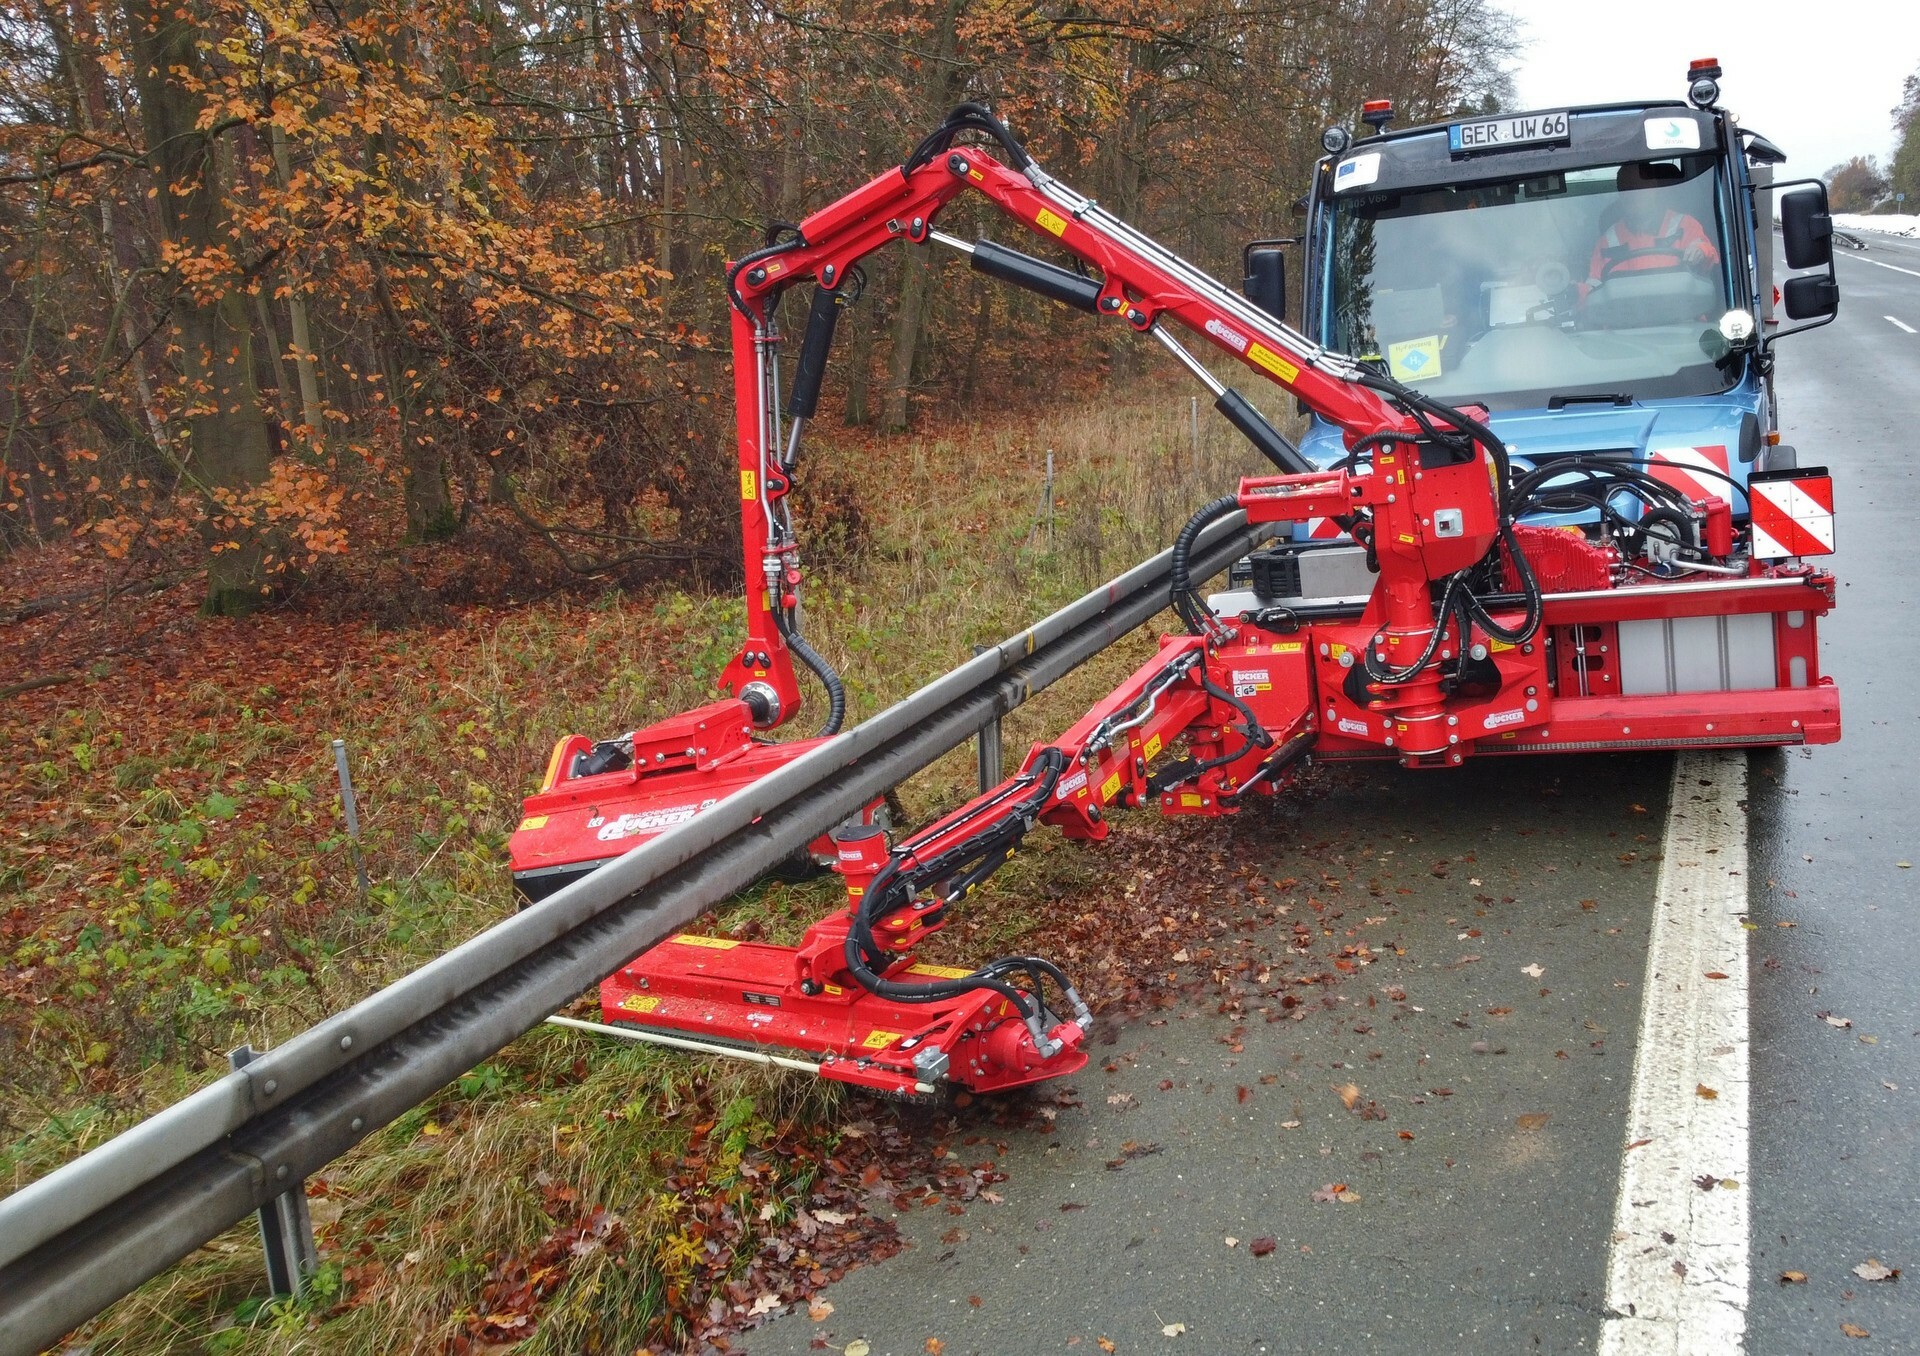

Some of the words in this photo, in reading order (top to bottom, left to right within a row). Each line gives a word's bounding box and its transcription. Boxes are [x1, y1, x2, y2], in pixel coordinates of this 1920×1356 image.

[1461, 124, 1498, 145] GER
[1512, 119, 1537, 139] UW
[1542, 116, 1566, 136] 66
